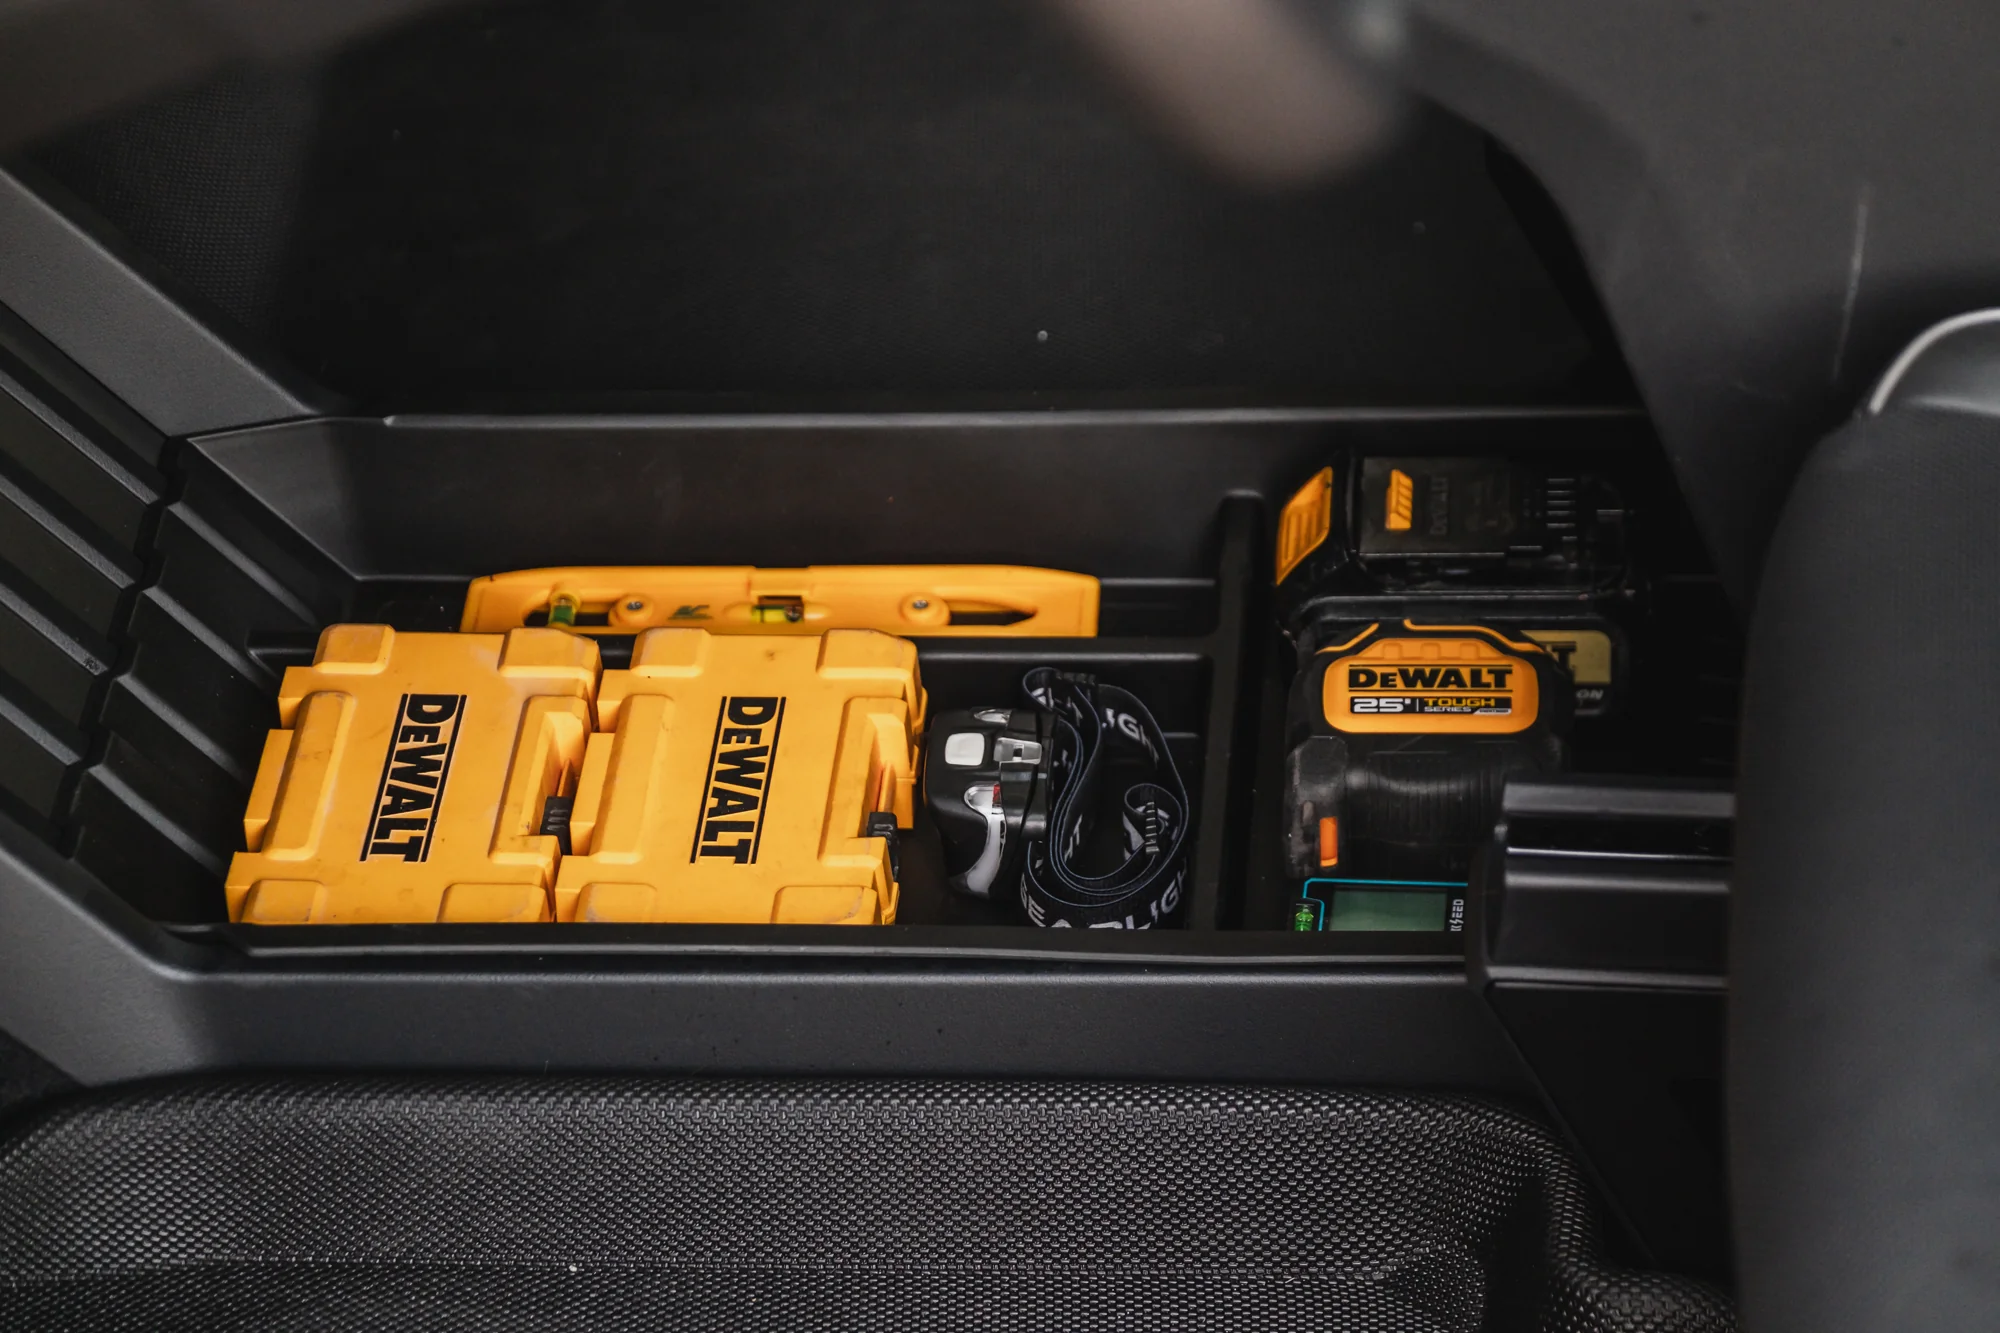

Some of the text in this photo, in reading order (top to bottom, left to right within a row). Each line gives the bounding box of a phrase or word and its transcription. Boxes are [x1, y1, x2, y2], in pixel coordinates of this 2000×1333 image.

[1348, 669, 1513, 688] DEWALT
[1424, 697, 1496, 707] TOUGH
[1424, 706, 1473, 714] SERIES
[372, 694, 459, 862] DEWALT
[701, 696, 778, 864] DEWALT
